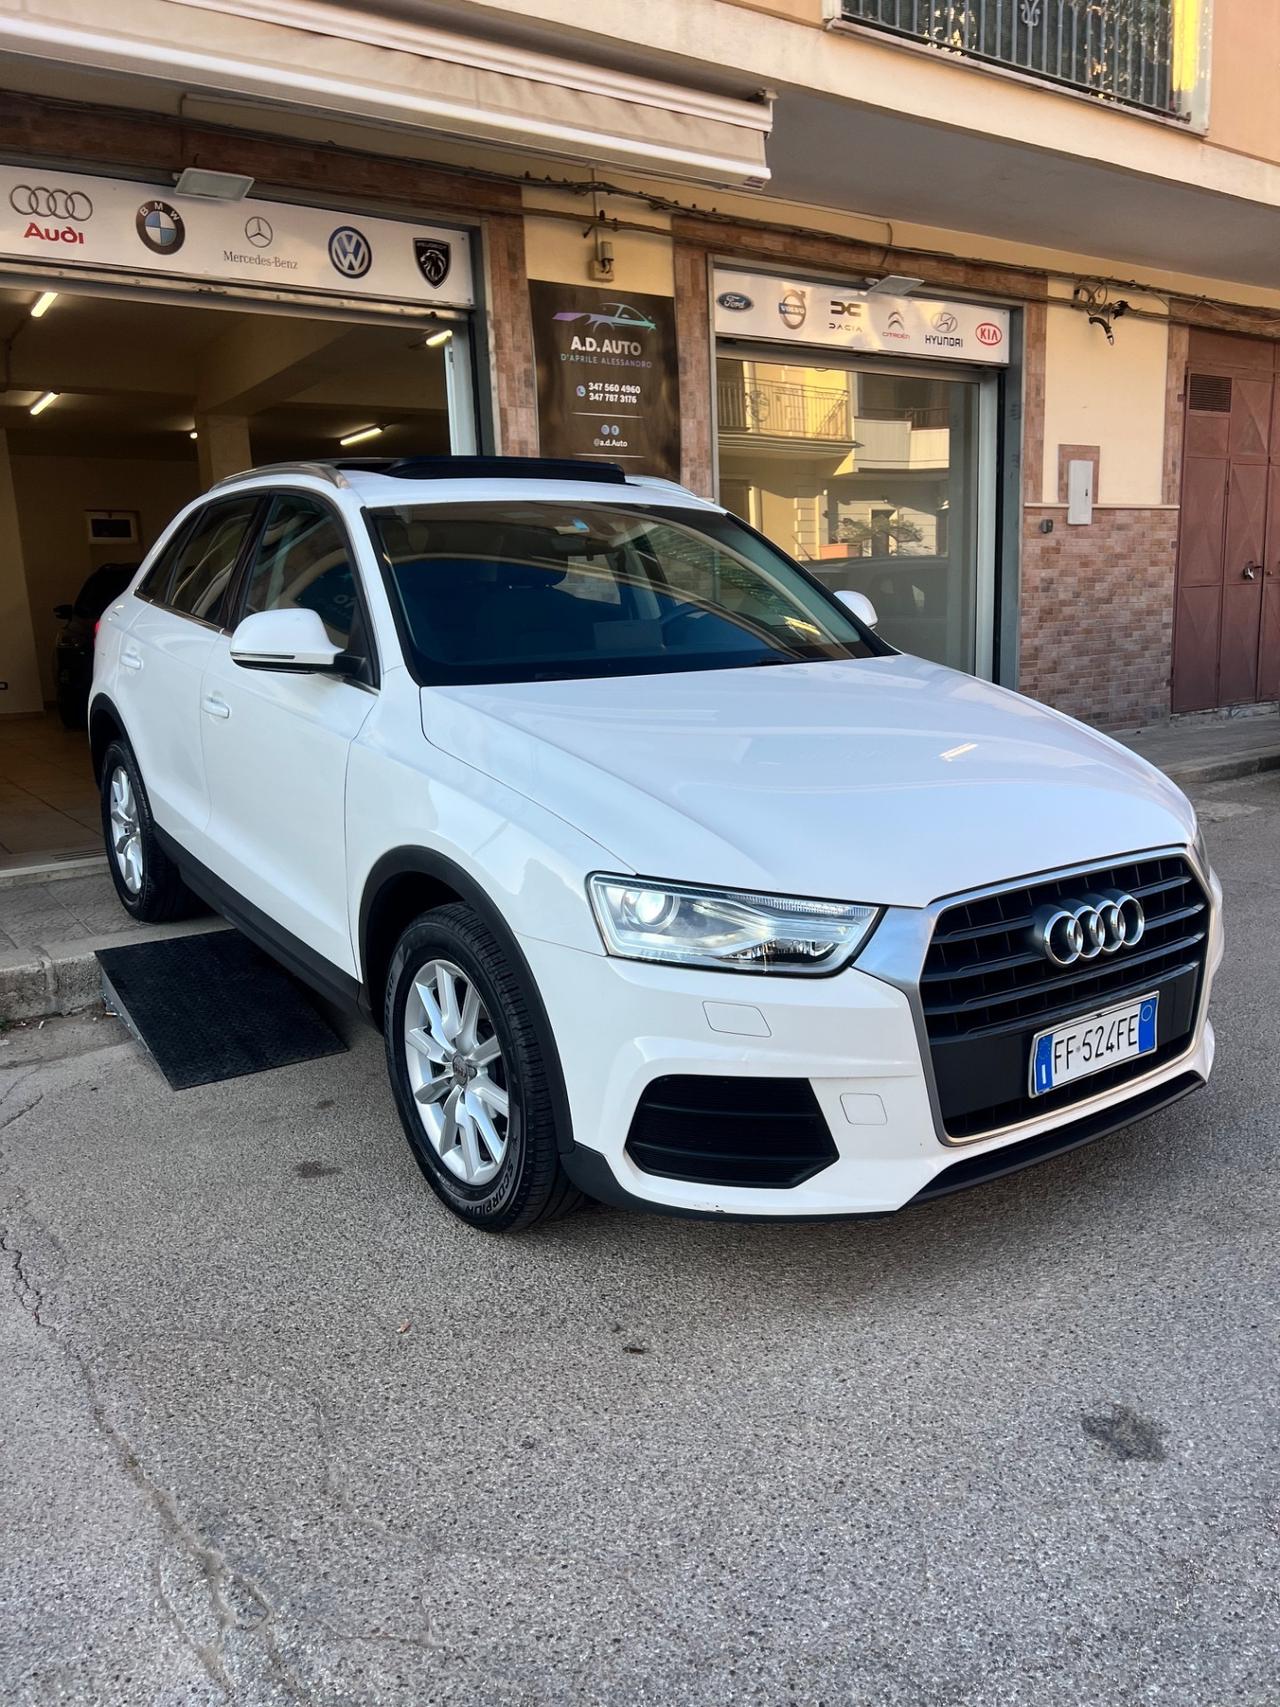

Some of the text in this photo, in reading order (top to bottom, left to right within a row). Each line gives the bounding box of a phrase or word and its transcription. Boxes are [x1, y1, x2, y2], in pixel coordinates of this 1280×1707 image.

[140, 202, 180, 221] BMW
[24, 222, 85, 244] Audi
[223, 250, 298, 270] Mercedes-Benz
[925, 334, 964, 348] HYUNDAI
[980, 328, 998, 341] KIA
[601, 357, 653, 368] ALESSANDRO
[588, 382, 603, 391] 347
[589, 392, 604, 401] 347
[466, 1158, 514, 1216] SCORPION
